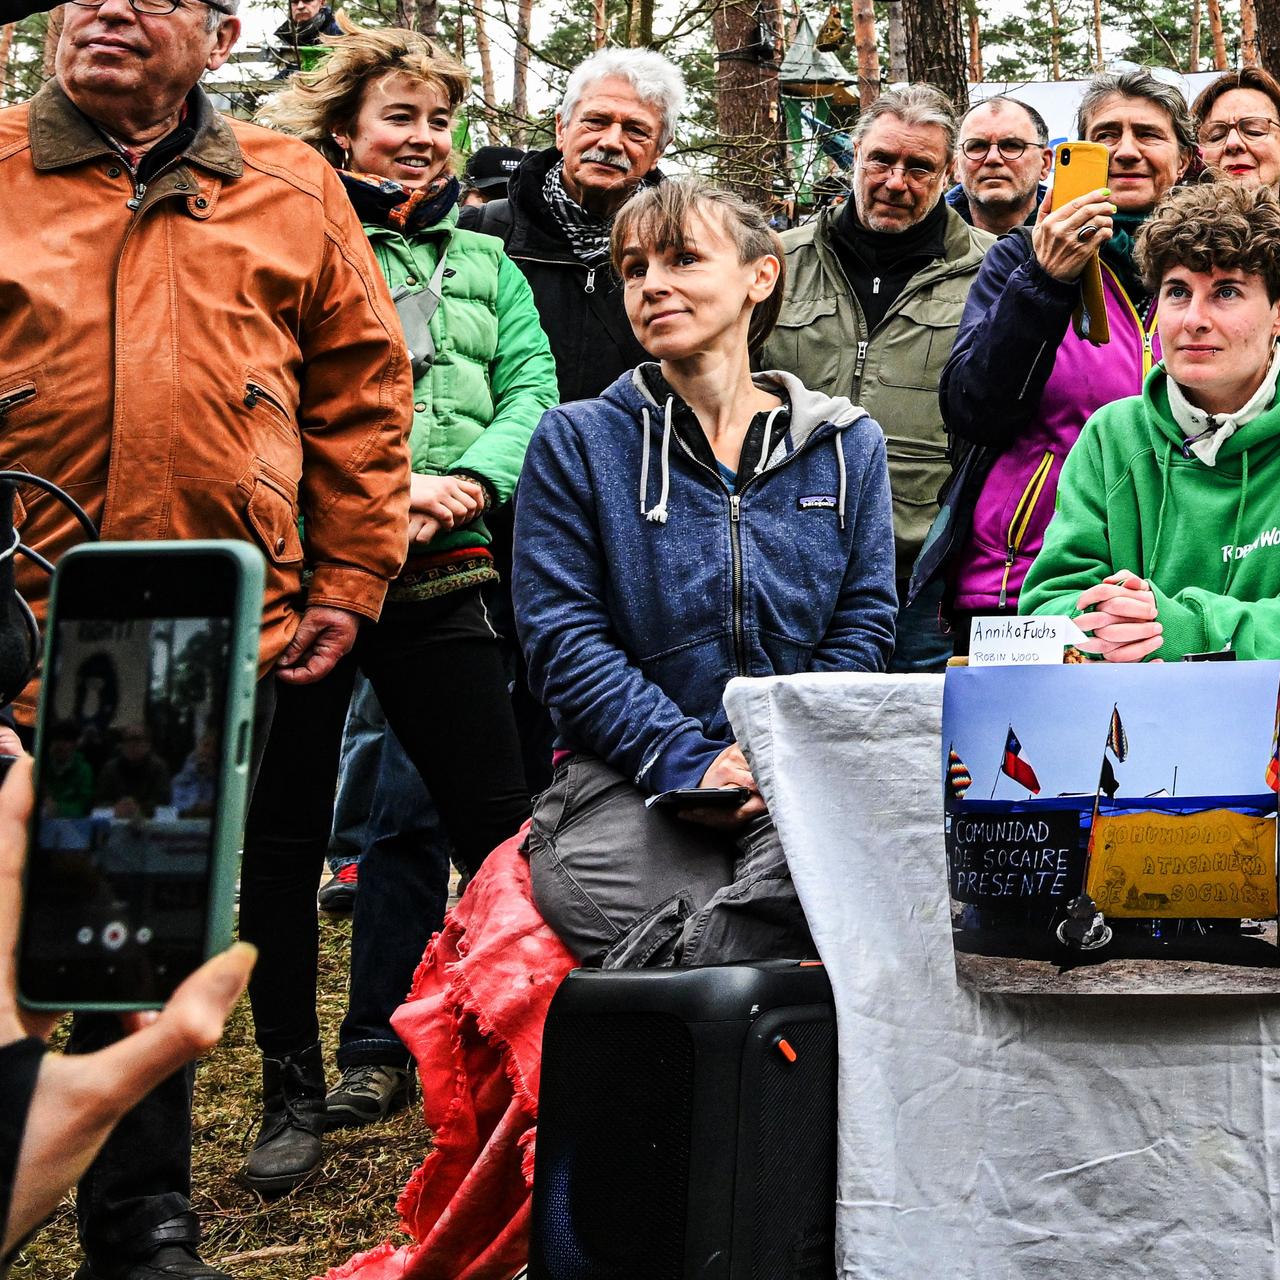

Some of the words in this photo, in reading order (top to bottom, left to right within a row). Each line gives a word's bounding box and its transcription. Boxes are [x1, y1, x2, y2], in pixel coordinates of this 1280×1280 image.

[973, 621, 1021, 641] Annika
[1023, 621, 1056, 639] Fuchs
[974, 652, 1006, 662] ROBIN
[1011, 652, 1040, 662] WOOD
[956, 820, 1050, 844] COMUNIDAD
[1103, 824, 1231, 845] COMUNIDAD
[954, 846, 972, 867] DE
[984, 848, 1069, 870] SOCAIRE
[957, 872, 1067, 896] PRESENTE
